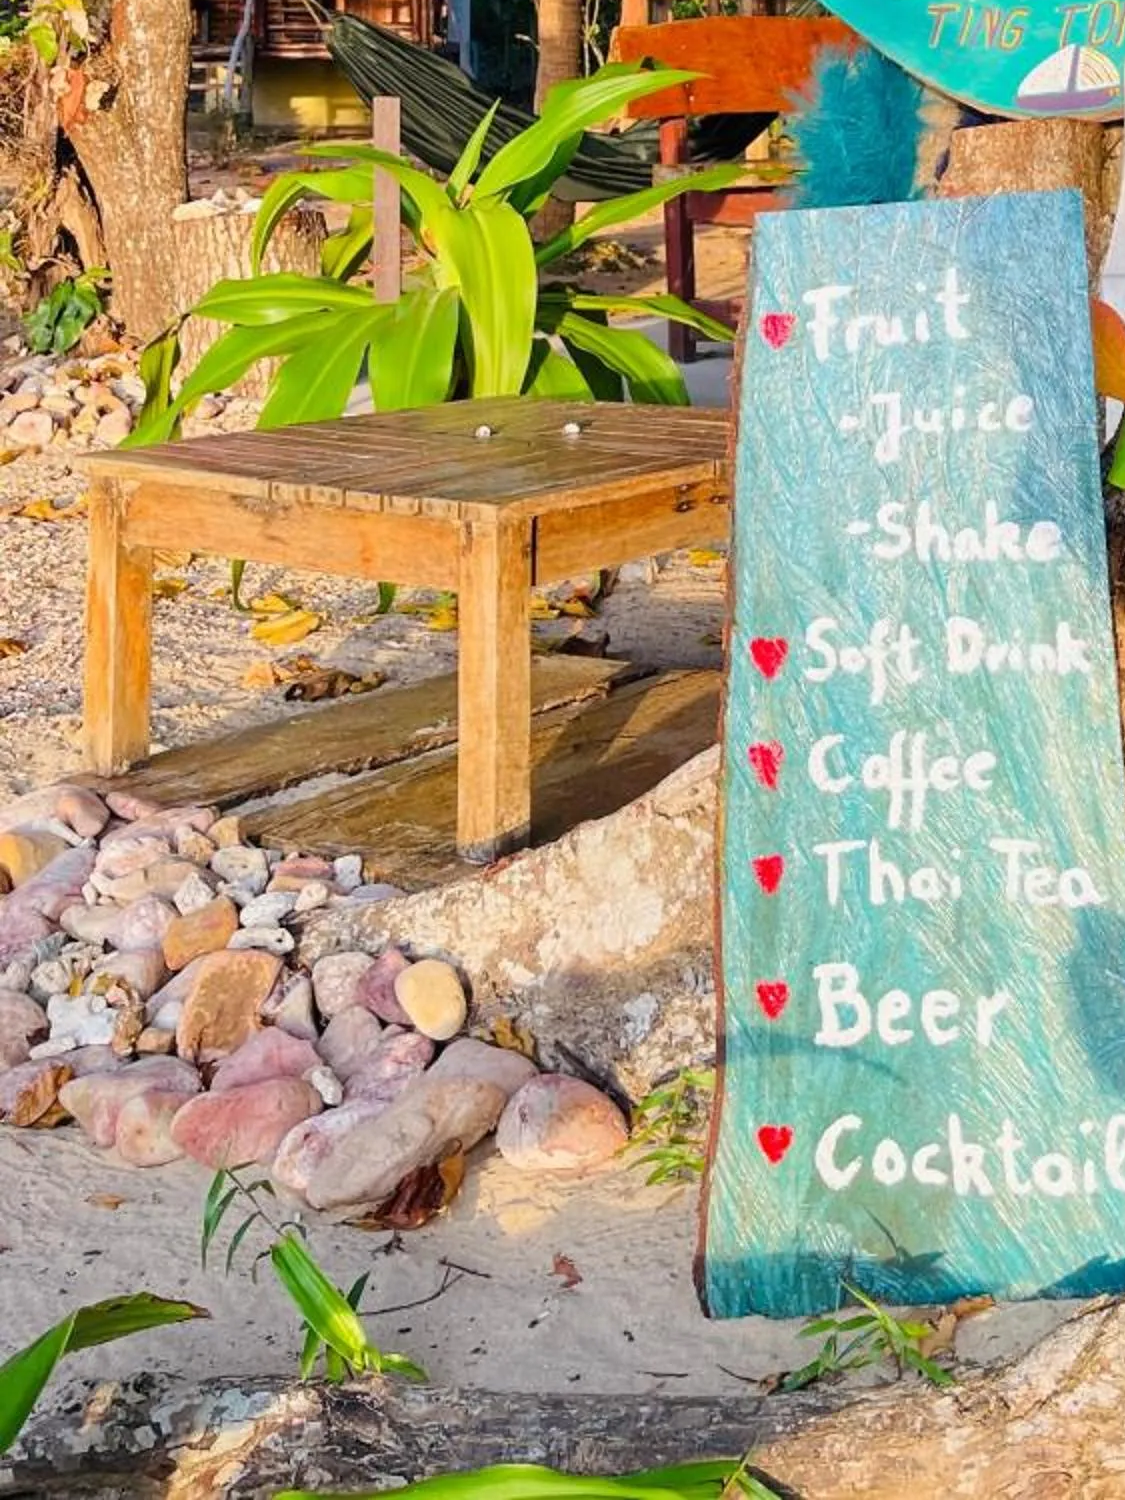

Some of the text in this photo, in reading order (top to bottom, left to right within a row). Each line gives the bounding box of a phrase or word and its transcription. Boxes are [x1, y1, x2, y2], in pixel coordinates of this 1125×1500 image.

[801, 267, 970, 363] Fruit
[844, 500, 1063, 562] -Shake
[803, 614, 1093, 706] Soft Drink
[807, 730, 998, 830] Coffee
[812, 837, 1107, 907] Thai Tea
[812, 961, 1012, 1048] Beer
